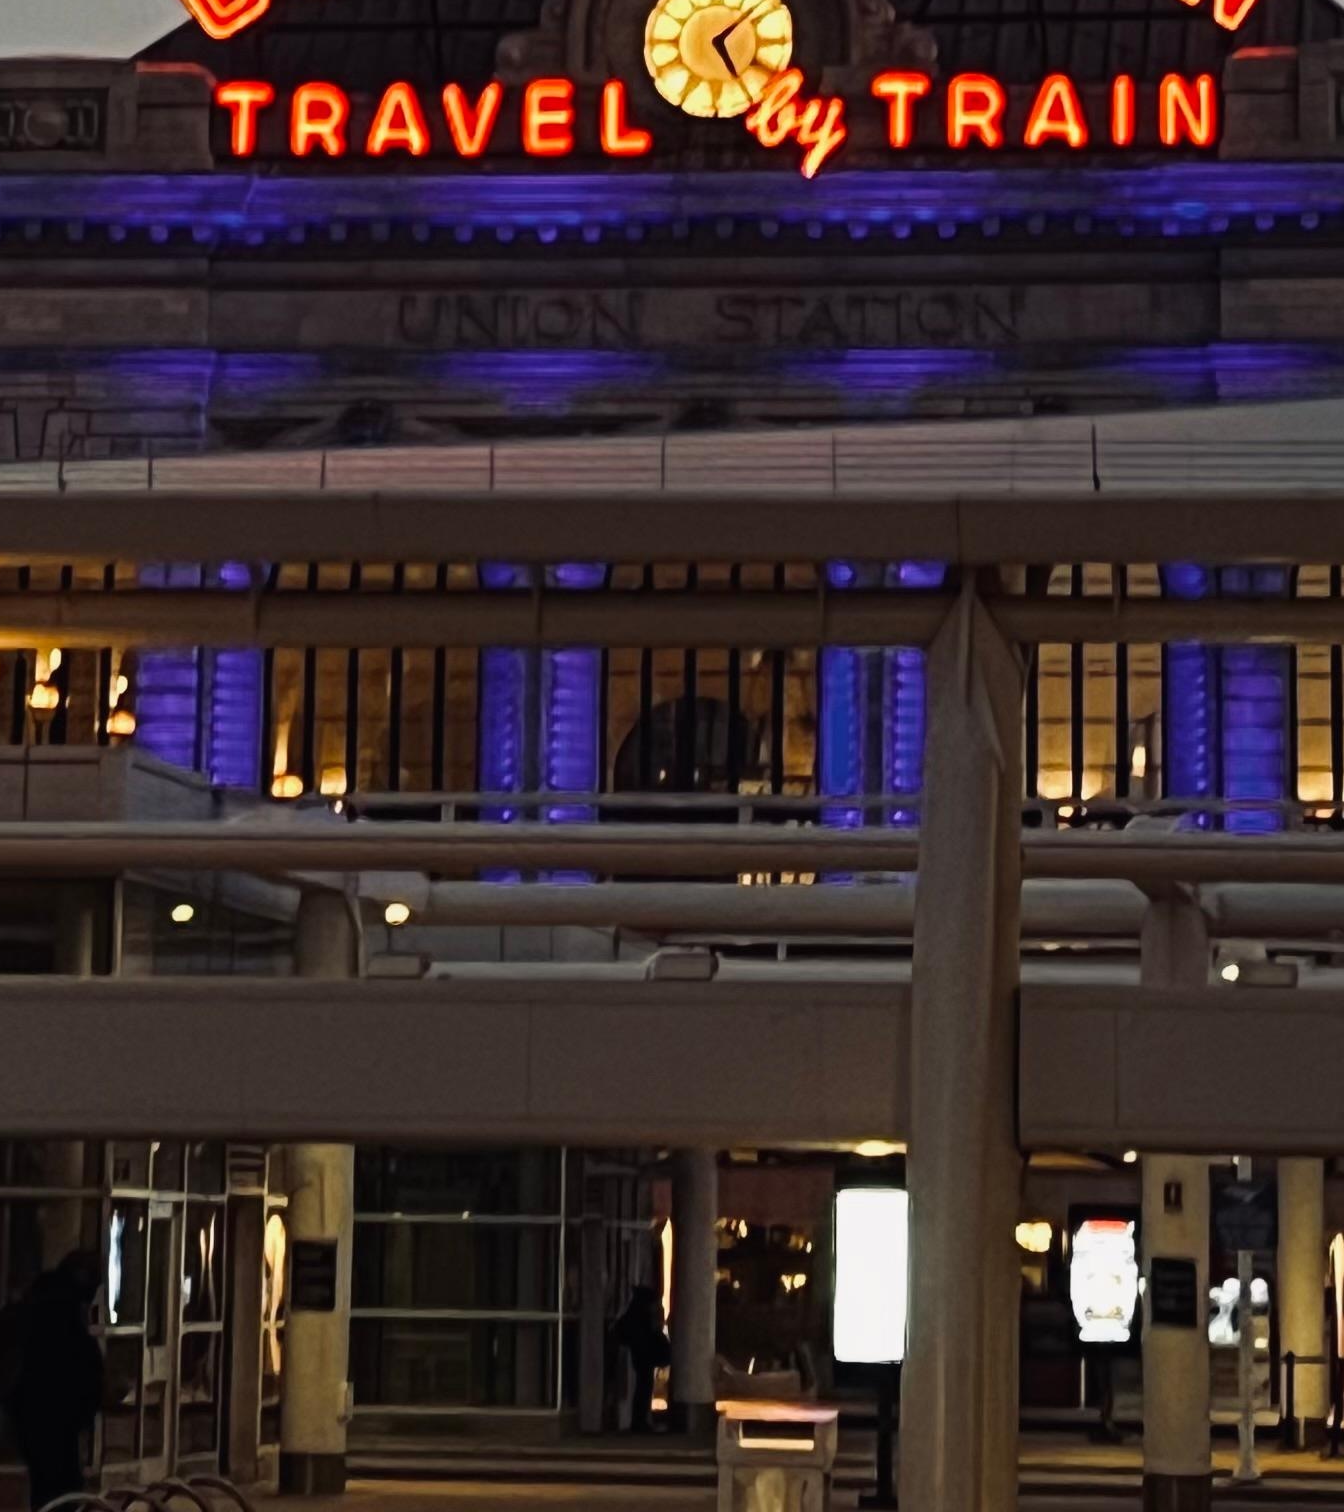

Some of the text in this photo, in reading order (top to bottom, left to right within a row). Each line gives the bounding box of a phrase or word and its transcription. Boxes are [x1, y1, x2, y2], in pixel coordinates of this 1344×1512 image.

[215, 67, 1218, 180] TRAVEL by TRAIN
[398, 291, 1027, 346] UNION STATION
